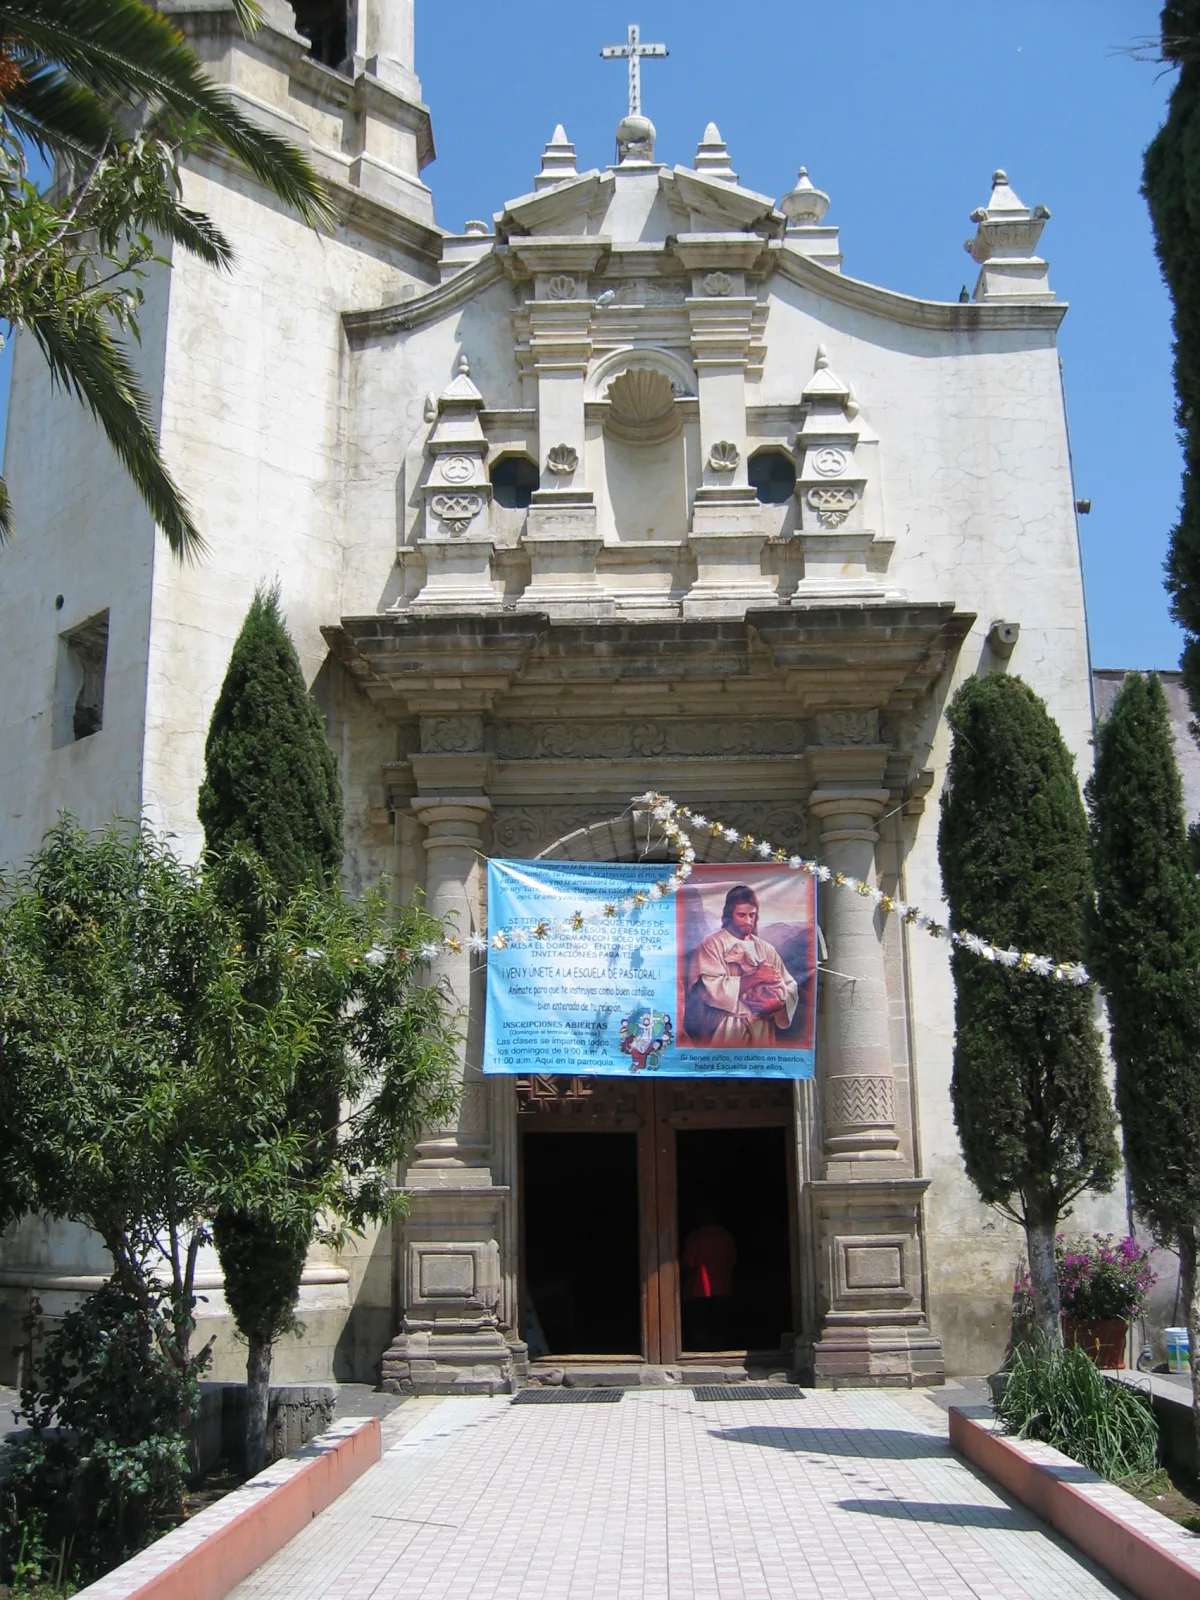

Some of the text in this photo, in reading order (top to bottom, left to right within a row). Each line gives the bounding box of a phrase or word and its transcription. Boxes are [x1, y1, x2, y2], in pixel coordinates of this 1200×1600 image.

[500, 886, 509, 894] yo
[574, 886, 598, 896] Porque
[509, 917, 518, 925] SI
[520, 917, 552, 926] TIENES
[593, 918, 652, 928] NQUIETUDES
[653, 920, 664, 928] DE
[610, 927, 617, 935] O
[640, 928, 651, 936] DE
[635, 936, 661, 944] VENIR
[510, 942, 533, 950] MISA
[534, 942, 545, 950] EL
[594, 943, 638, 952] ENTONCES
[531, 948, 586, 958] INVITACIÓN
[521, 967, 528, 978] Y
[528, 963, 553, 978] ÚNETE
[554, 967, 561, 978] A
[562, 967, 571, 978] LA
[573, 966, 606, 979] ESCUELA
[607, 967, 617, 980] DE
[533, 986, 548, 997] para
[548, 986, 559, 997] que
[560, 985, 569, 994] te
[569, 984, 598, 998] instruyas
[598, 987, 614, 996] como
[615, 985, 630, 996] buen
[537, 1001, 551, 1011] bien
[552, 1000, 580, 1011] enterado
[581, 1001, 589, 1012] de
[590, 1002, 598, 1012] tu
[502, 1021, 608, 1030] INSCRIPCIONES ABIERTAS
[496, 1038, 510, 1046] Las
[512, 1037, 538, 1045] clases
[551, 1037, 586, 1047] imparten
[588, 1038, 610, 1047] todos
[497, 1047, 509, 1056] los
[511, 1047, 549, 1056] domingos
[551, 1047, 562, 1055] de
[601, 1048, 608, 1056] A
[555, 1057, 566, 1065] en
[680, 1053, 688, 1061] Si
